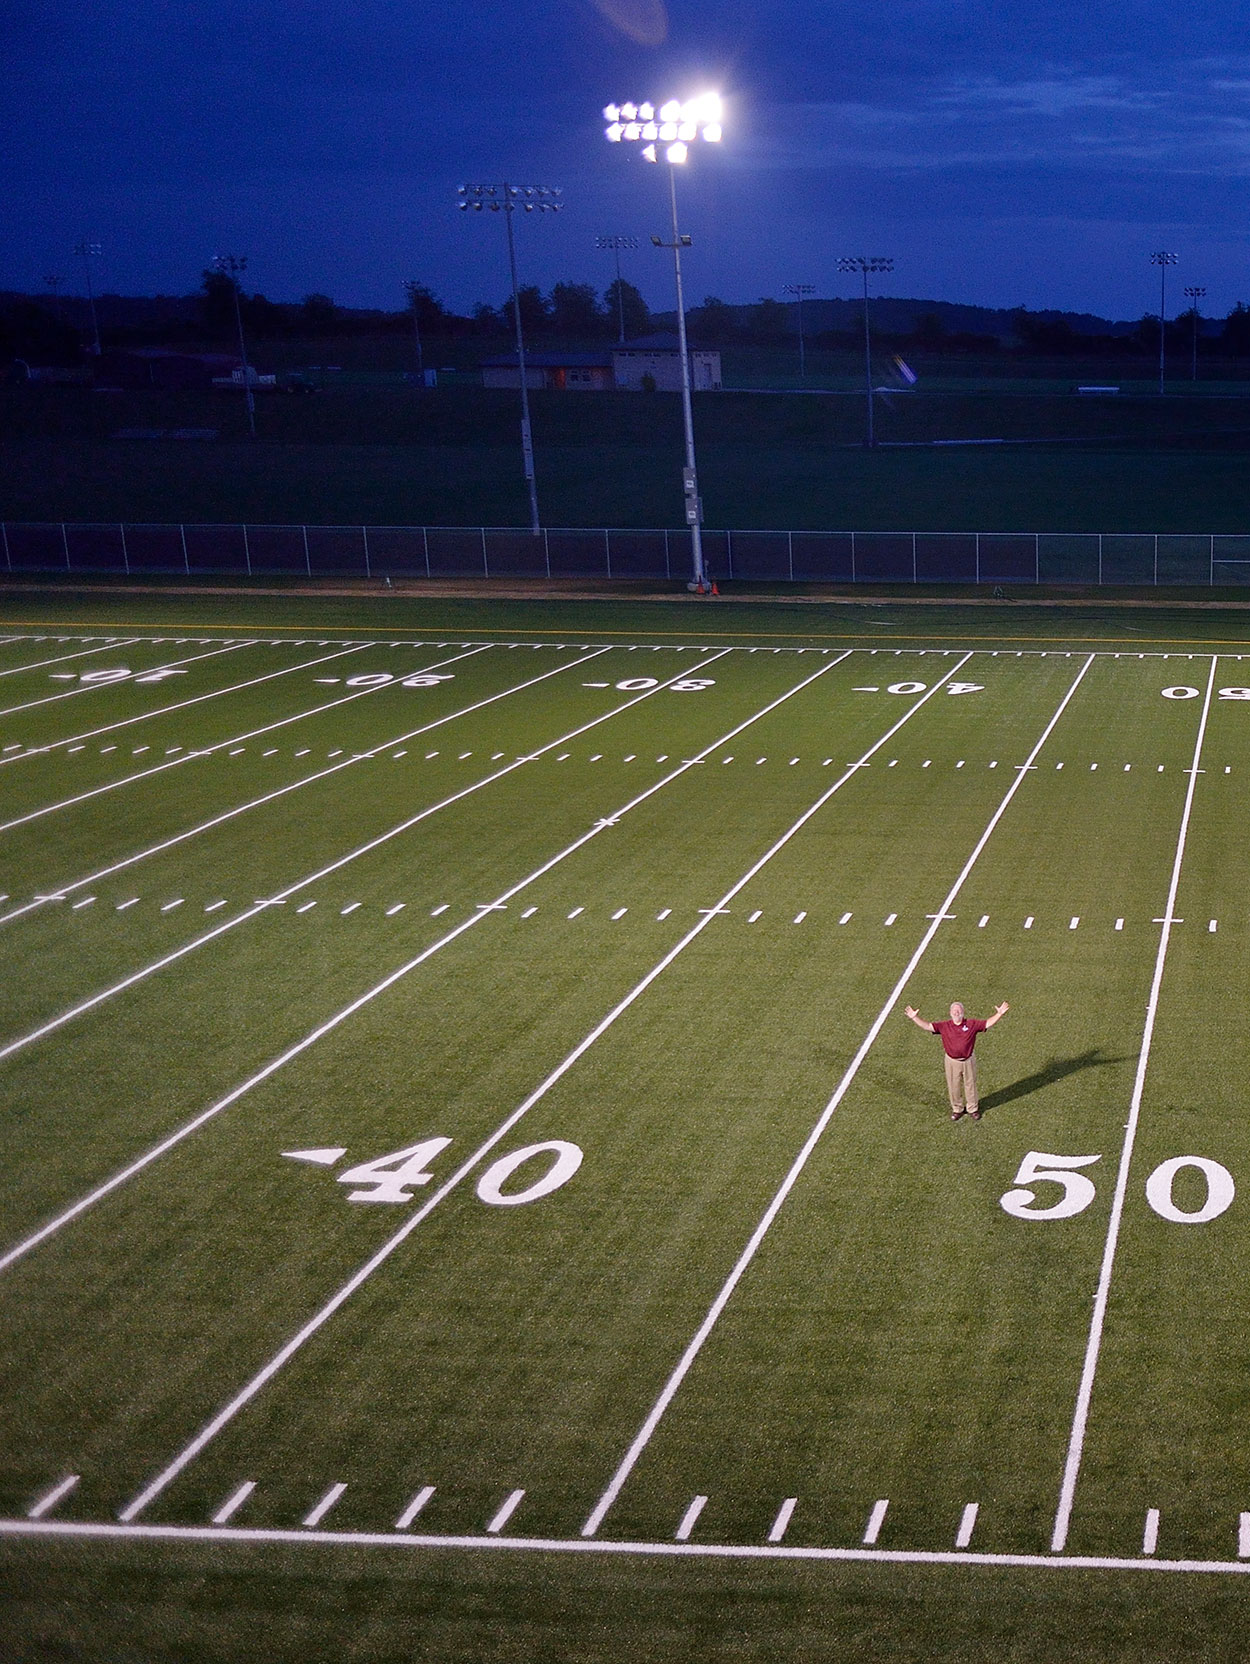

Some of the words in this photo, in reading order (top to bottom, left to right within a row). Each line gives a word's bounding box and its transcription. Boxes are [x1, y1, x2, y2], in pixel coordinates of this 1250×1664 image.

[345, 673, 456, 687] 20
[615, 677, 716, 692] 30
[886, 681, 985, 696] 40
[336, 1136, 584, 1206] 40
[999, 1150, 1236, 1224] 50
